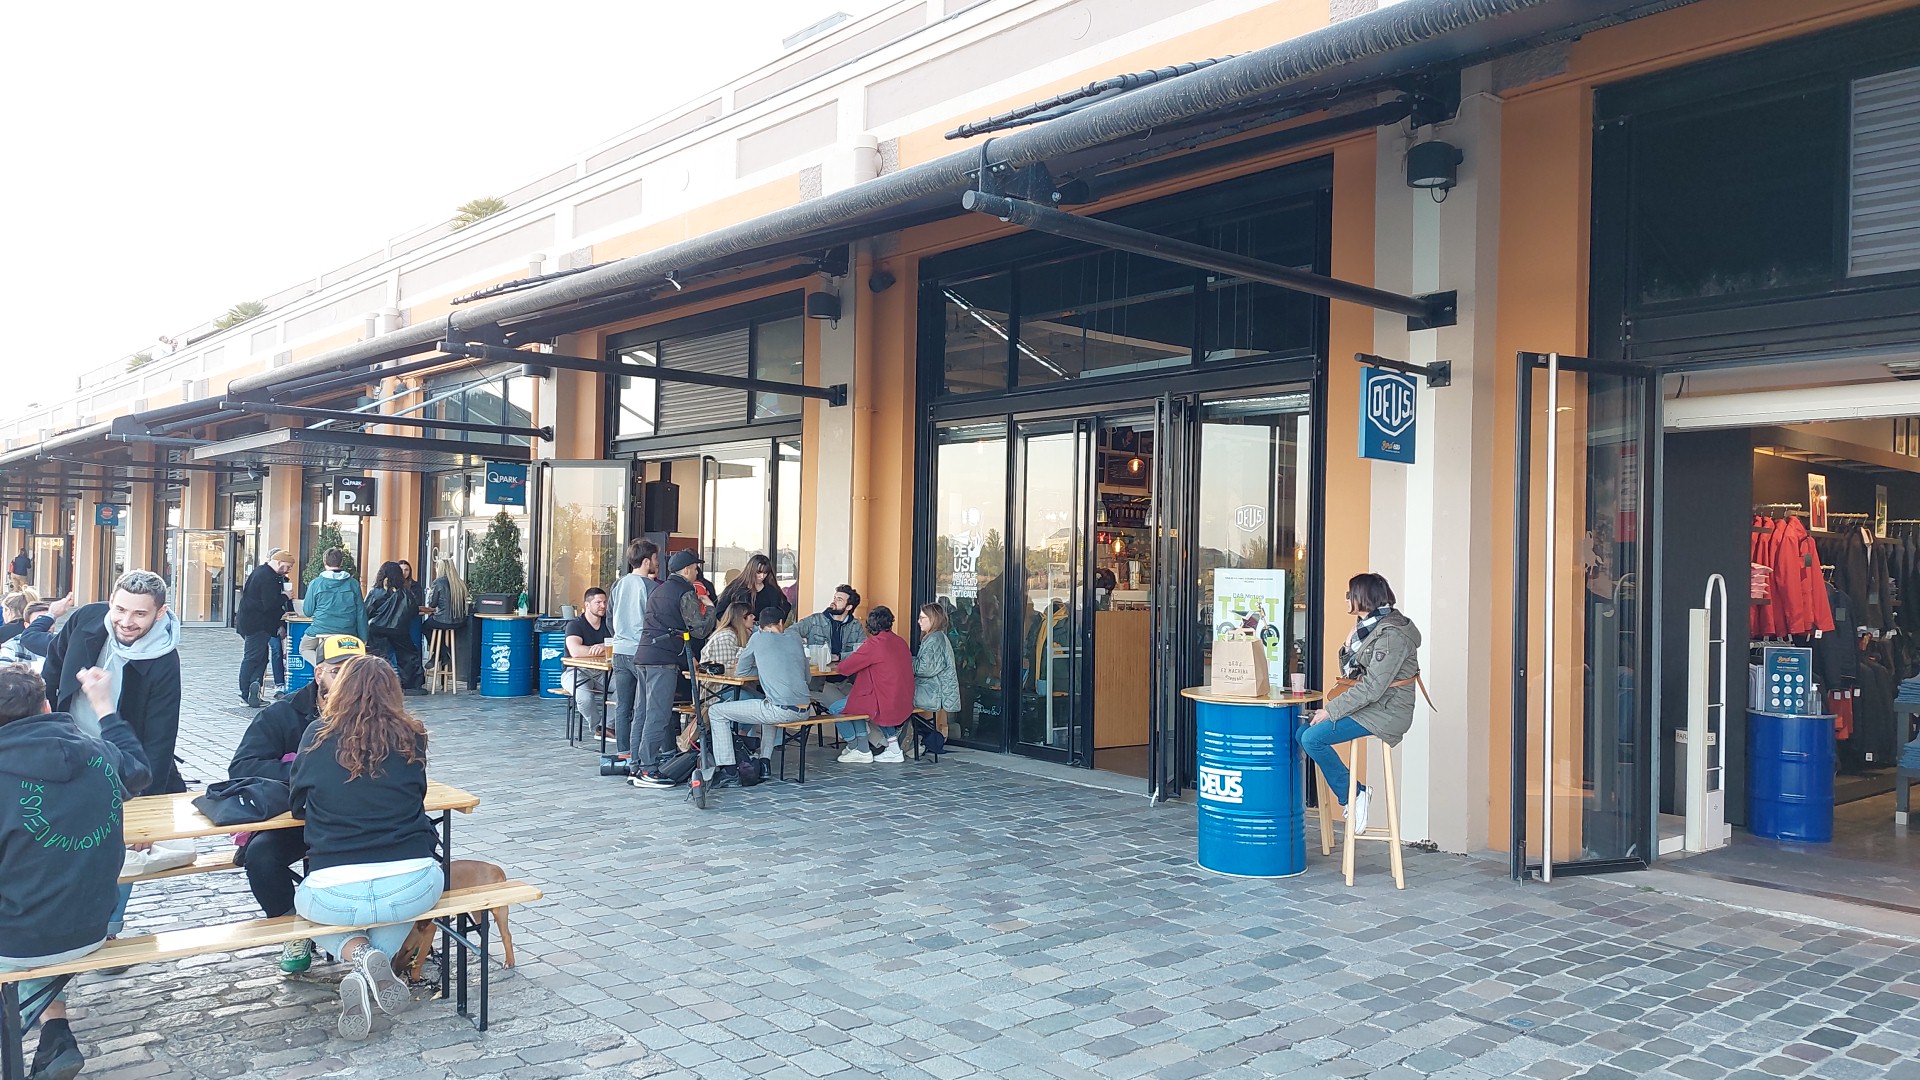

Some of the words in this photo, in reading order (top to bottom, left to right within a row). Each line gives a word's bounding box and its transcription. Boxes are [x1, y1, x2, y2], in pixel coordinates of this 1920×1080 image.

[1373, 383, 1411, 426] DEUS
[339, 490, 356, 511] P
[352, 504, 371, 512] H16
[1237, 508, 1262, 527] DEUS
[1199, 772, 1243, 798] DEUS
